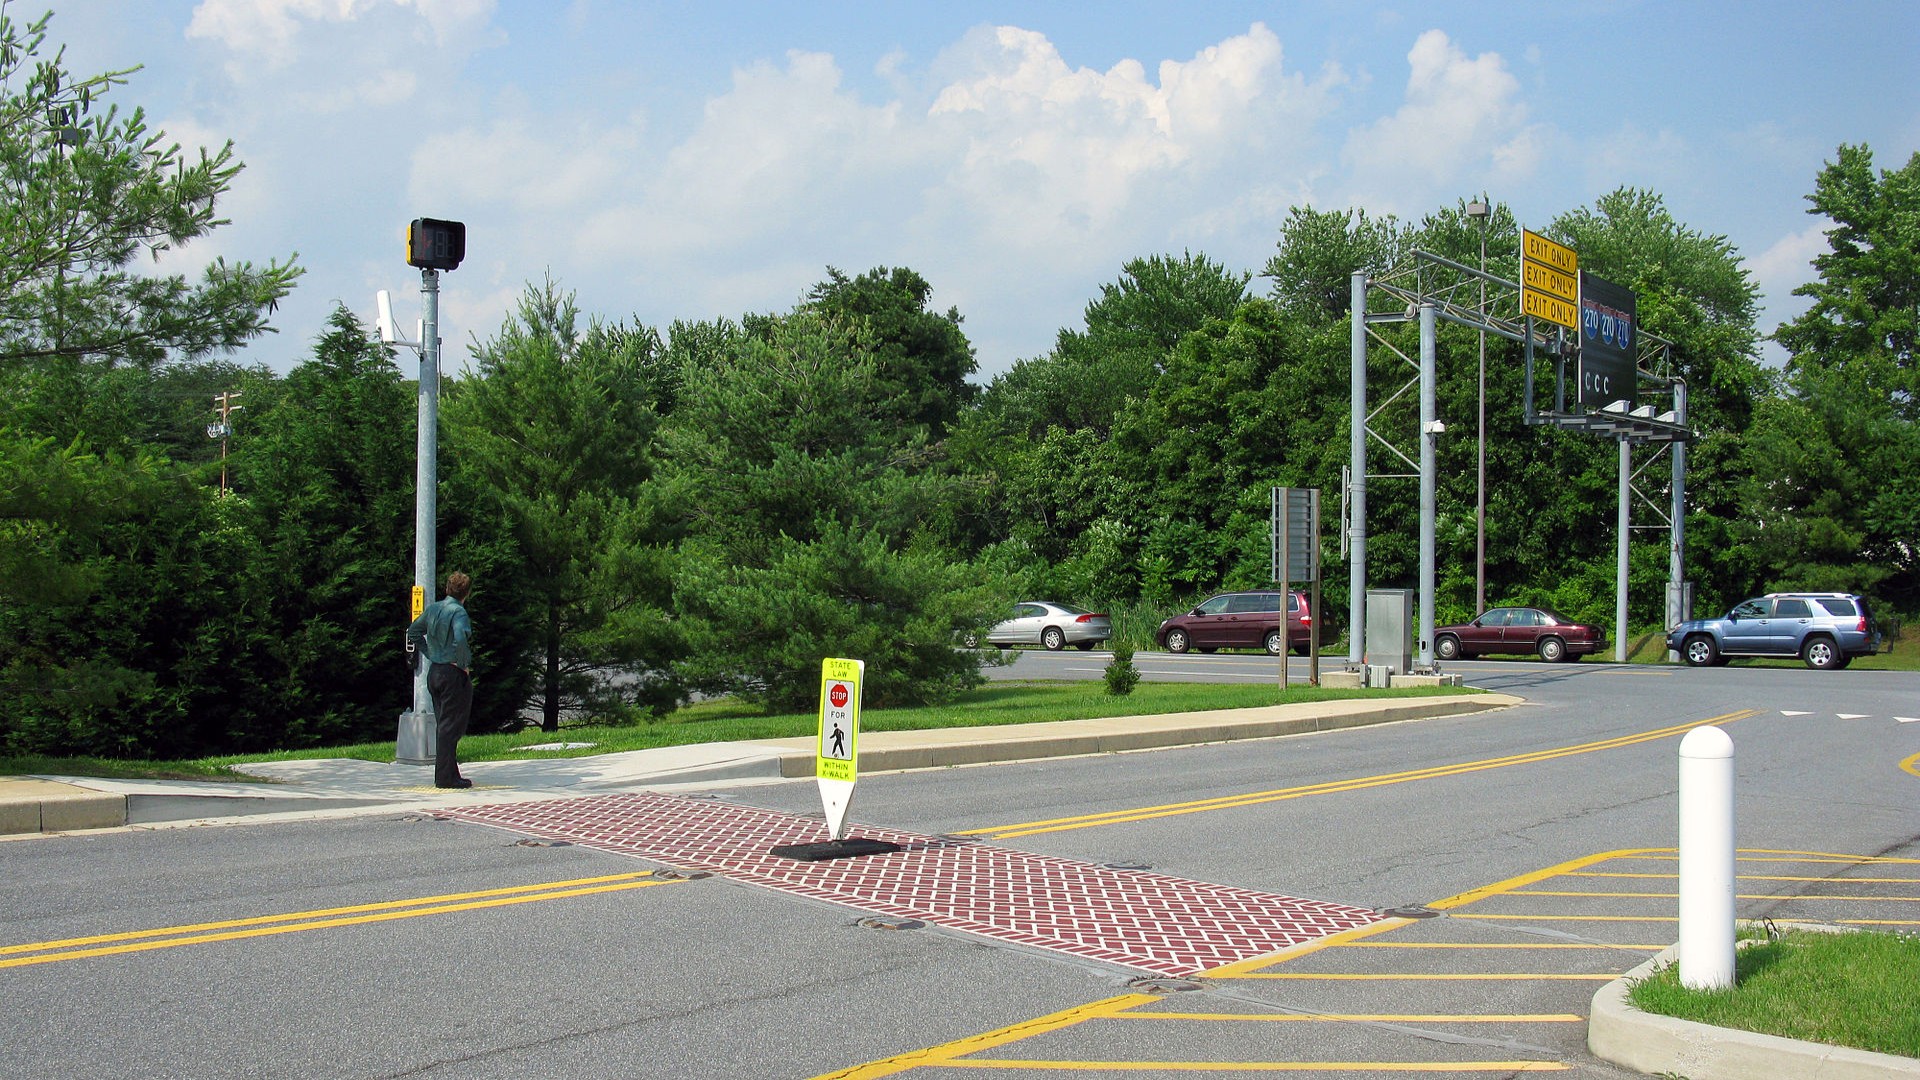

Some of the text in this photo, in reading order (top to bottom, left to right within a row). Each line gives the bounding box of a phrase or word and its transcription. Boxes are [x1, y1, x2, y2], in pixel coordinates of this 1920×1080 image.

[1530, 239, 1571, 268] EXIT ONLY
[1527, 265, 1573, 295] EXIT ONLY
[1526, 294, 1547, 315] EXIT
[1550, 302, 1574, 324] ONLY
[1584, 309, 1599, 330] 270
[1602, 315, 1615, 337] 270
[830, 661, 851, 670] STATE
[832, 670, 847, 678] LAW
[831, 691, 847, 700] STOP
[830, 711, 846, 719] FOR
[824, 762, 849, 771] WITHIN
[822, 770, 850, 779] X-WALK
